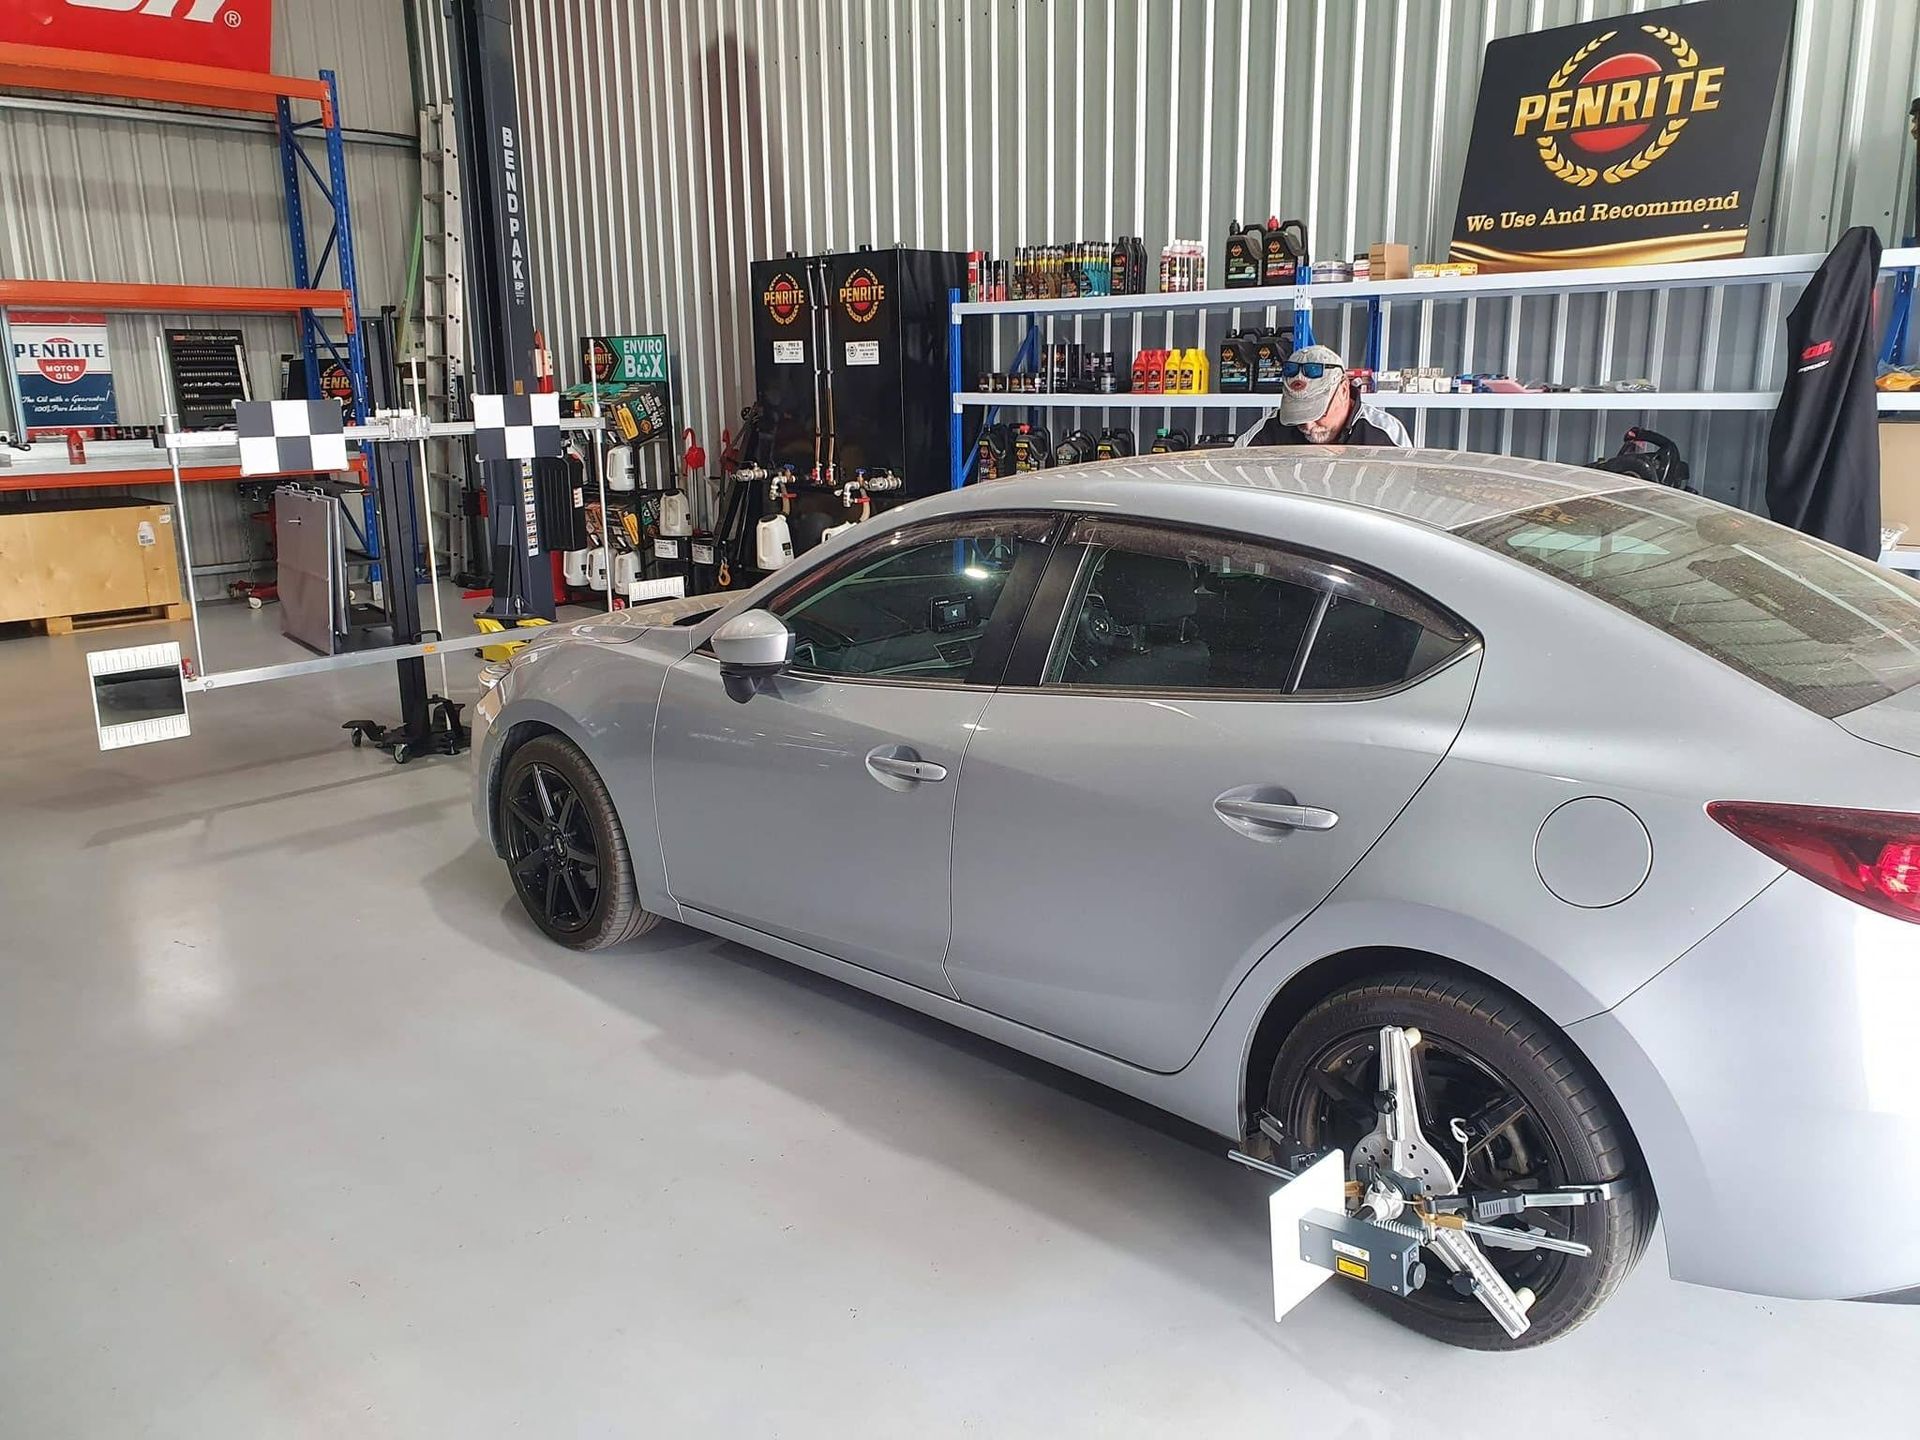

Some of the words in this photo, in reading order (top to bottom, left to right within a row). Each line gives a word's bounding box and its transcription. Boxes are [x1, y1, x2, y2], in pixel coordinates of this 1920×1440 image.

[1513, 67, 1725, 137] PENRITE
[1467, 215, 1495, 232] We
[1500, 211, 1536, 229] Use
[1540, 205, 1586, 227] And
[1590, 191, 1741, 221] Recommend
[764, 290, 805, 305] PENRITE
[839, 285, 885, 303] PENRITE
[14, 343, 105, 358] PENRITE
[623, 339, 663, 354] ENVIRO
[45, 365, 80, 373] MOTOR
[36, 395, 49, 403] Oil
